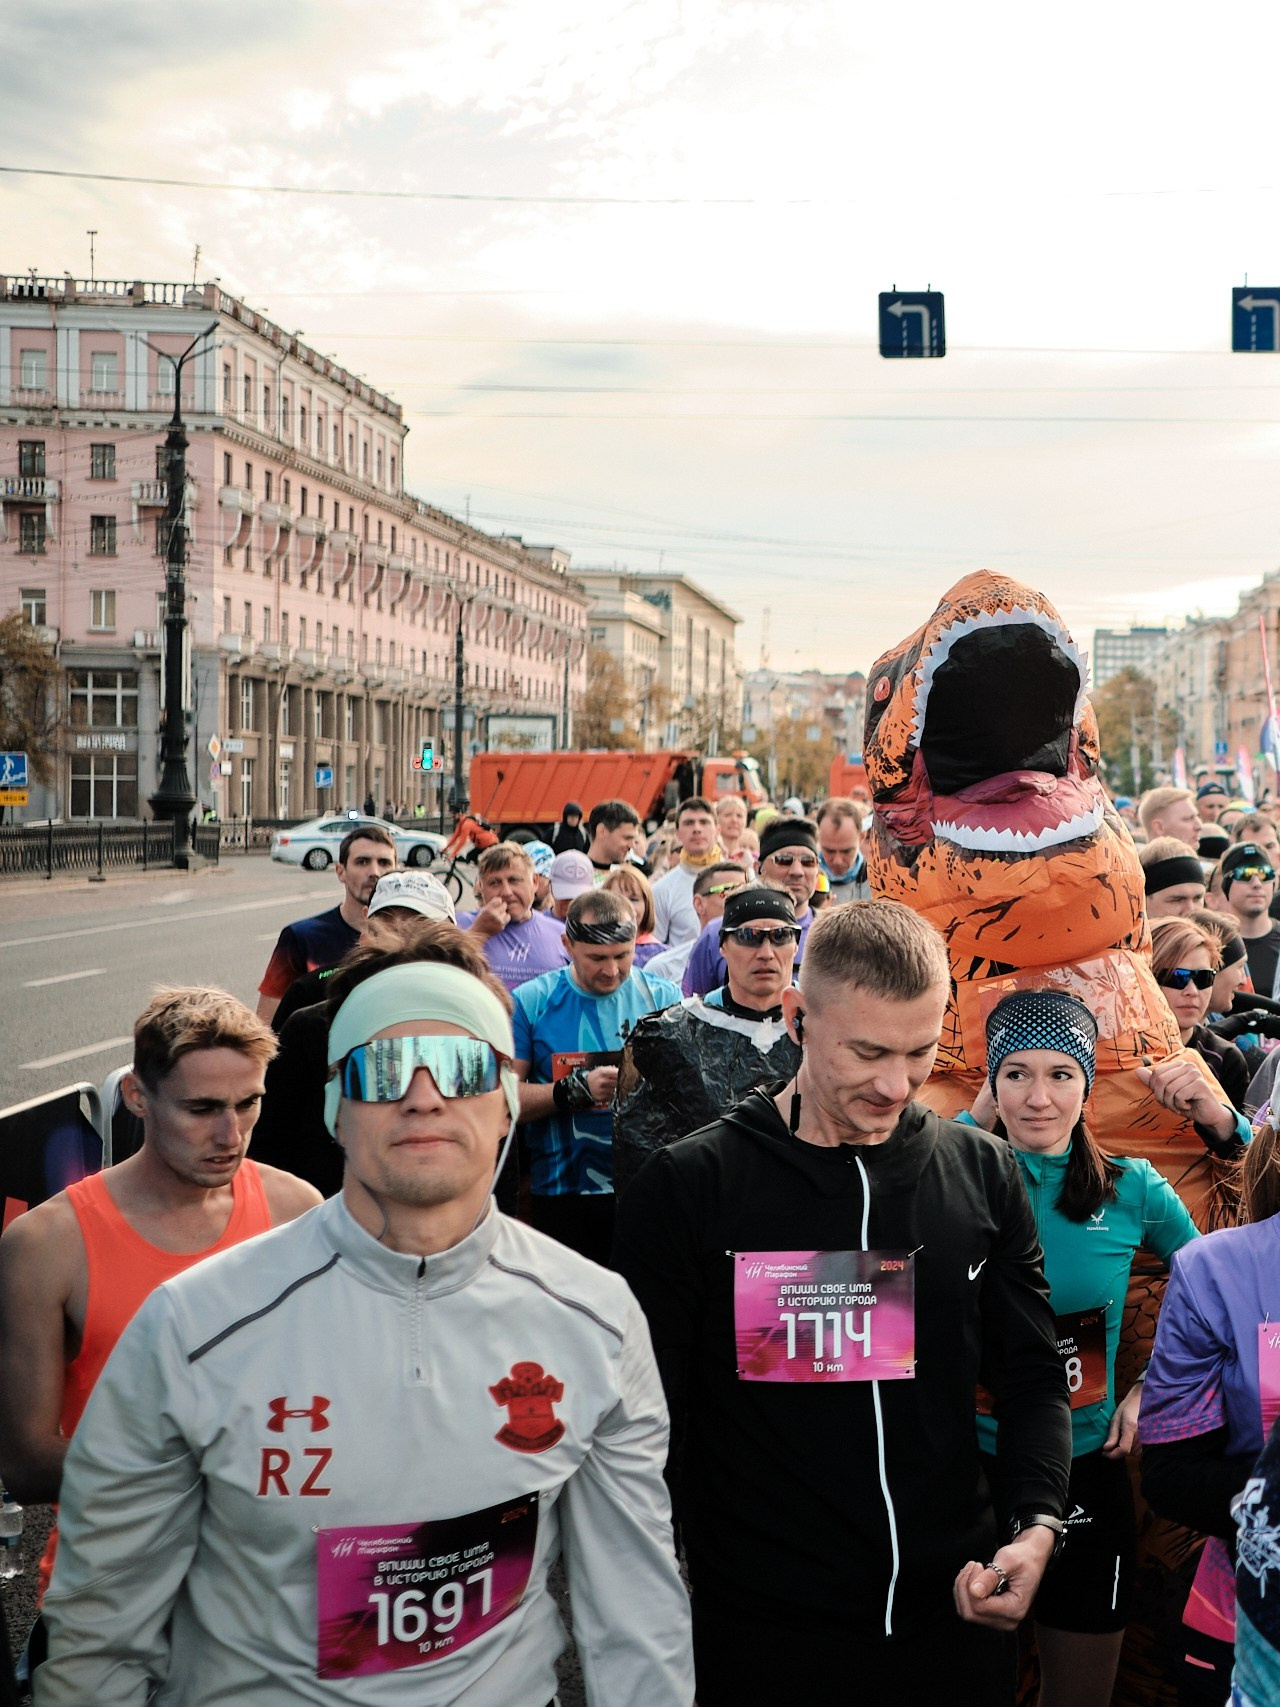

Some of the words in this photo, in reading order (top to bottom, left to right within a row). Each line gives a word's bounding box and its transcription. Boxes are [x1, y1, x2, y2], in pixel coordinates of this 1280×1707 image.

[880, 1260, 904, 1271] 2024
[765, 1271, 797, 1279] Марафон
[780, 1285, 817, 1295] ВПИШИ
[821, 1284, 846, 1294] СВОЕ
[849, 1283, 872, 1293] ИМЯ
[778, 1297, 785, 1307] В
[787, 1296, 836, 1307] ИСТОРИЮ
[838, 1295, 877, 1306] ГОРОДА
[1080, 1316, 1098, 1327] 2024
[779, 1310, 871, 1360] 1714
[1058, 1345, 1078, 1355] РОДА
[813, 1362, 824, 1372] 10
[256, 1447, 332, 1497] RZ
[378, 1558, 425, 1572] ВПИШИ
[428, 1552, 460, 1568] СВОЕ
[464, 1542, 490, 1559] ИМЯ
[373, 1576, 383, 1586] В
[387, 1568, 448, 1585] ИСТОРИЮ
[451, 1552, 495, 1576] ГОРОДА
[368, 1568, 493, 1646] 1697
[418, 1641, 430, 1654] 10
